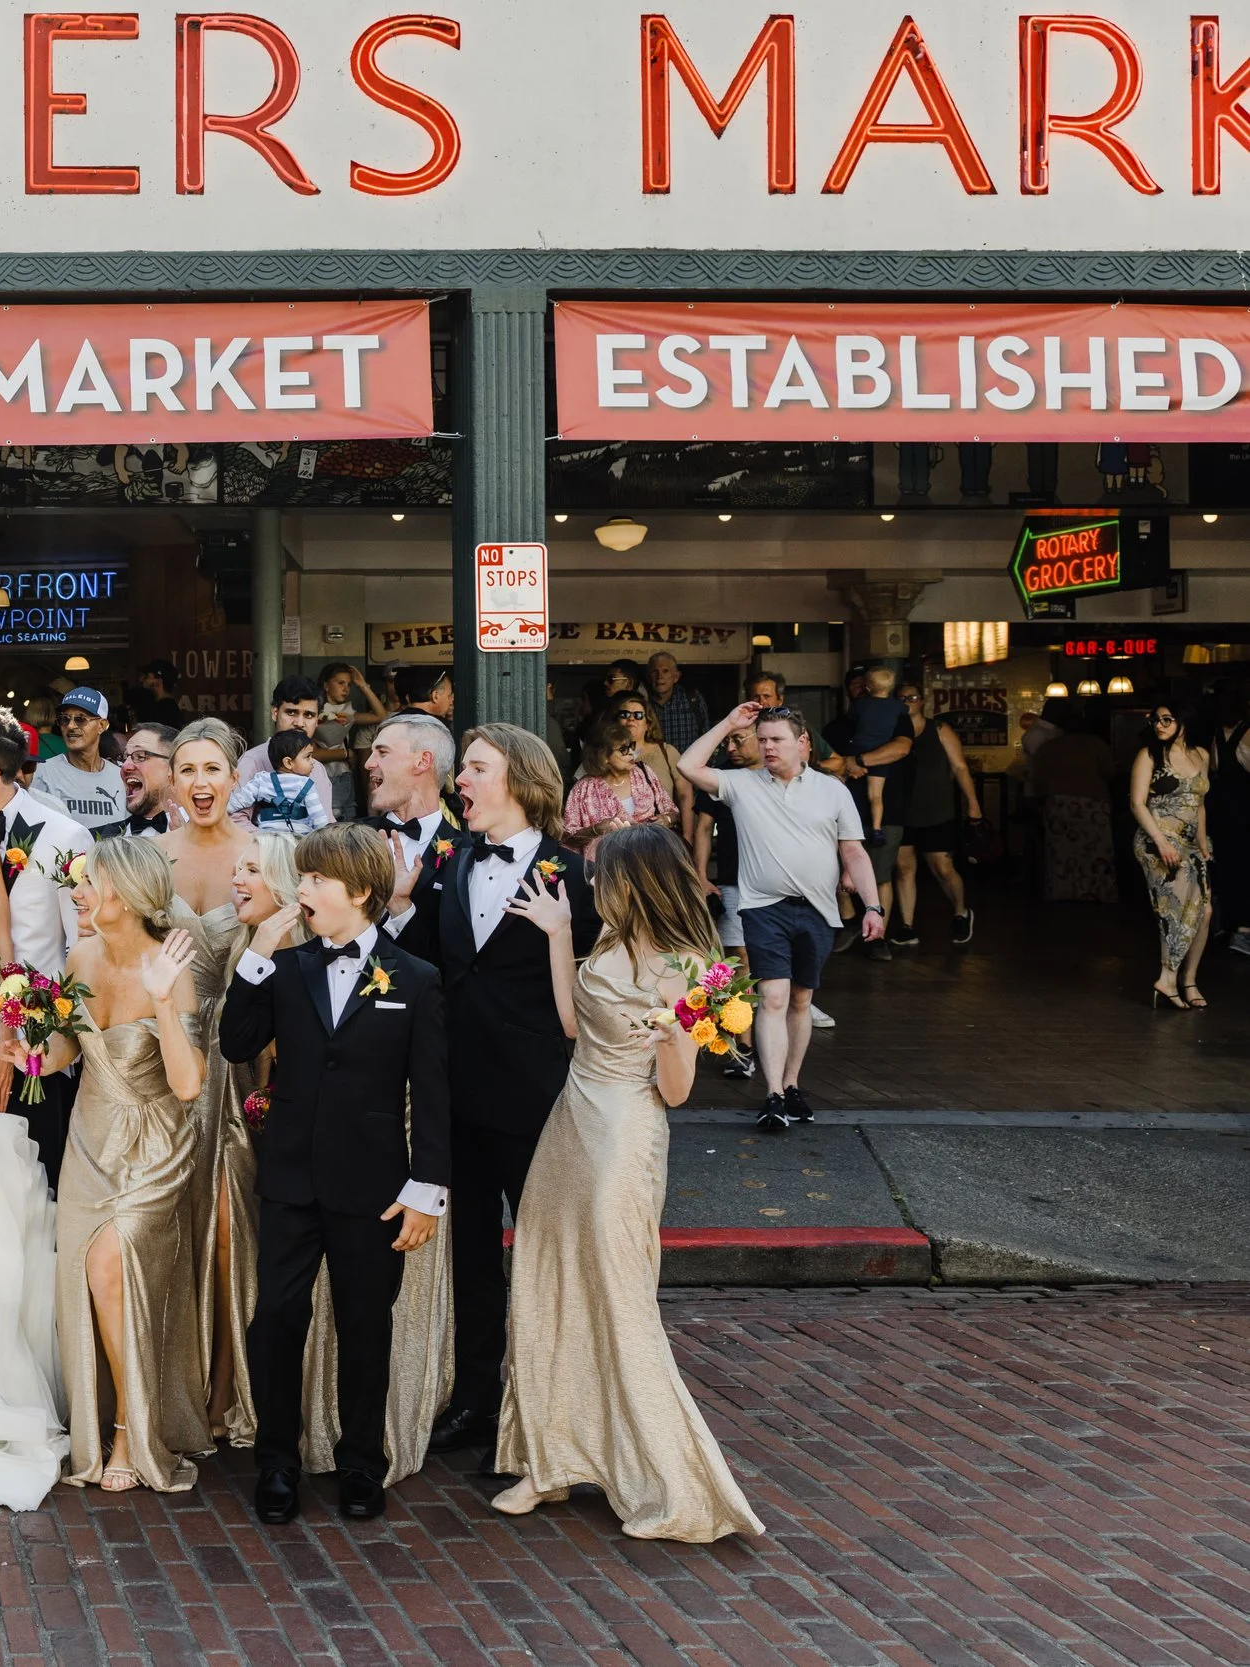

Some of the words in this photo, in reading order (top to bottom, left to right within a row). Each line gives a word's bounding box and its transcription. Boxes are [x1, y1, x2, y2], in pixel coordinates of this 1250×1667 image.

[640, 14, 1250, 195] MARK
[596, 333, 1242, 411] ESTABLISHED
[481, 549, 499, 563] NO
[1036, 528, 1100, 559] ROTARY
[486, 570, 537, 587] STOPS
[1025, 552, 1119, 592] GROCERY
[17, 632, 67, 642] SEATING
[382, 625, 454, 651] PIKE
[595, 622, 736, 648] BAKERY
[1065, 639, 1157, 656] BAR-B-QUE
[170, 649, 253, 679] LOWER
[933, 688, 1008, 713] PIKES
[66, 799, 114, 816] PUMA
